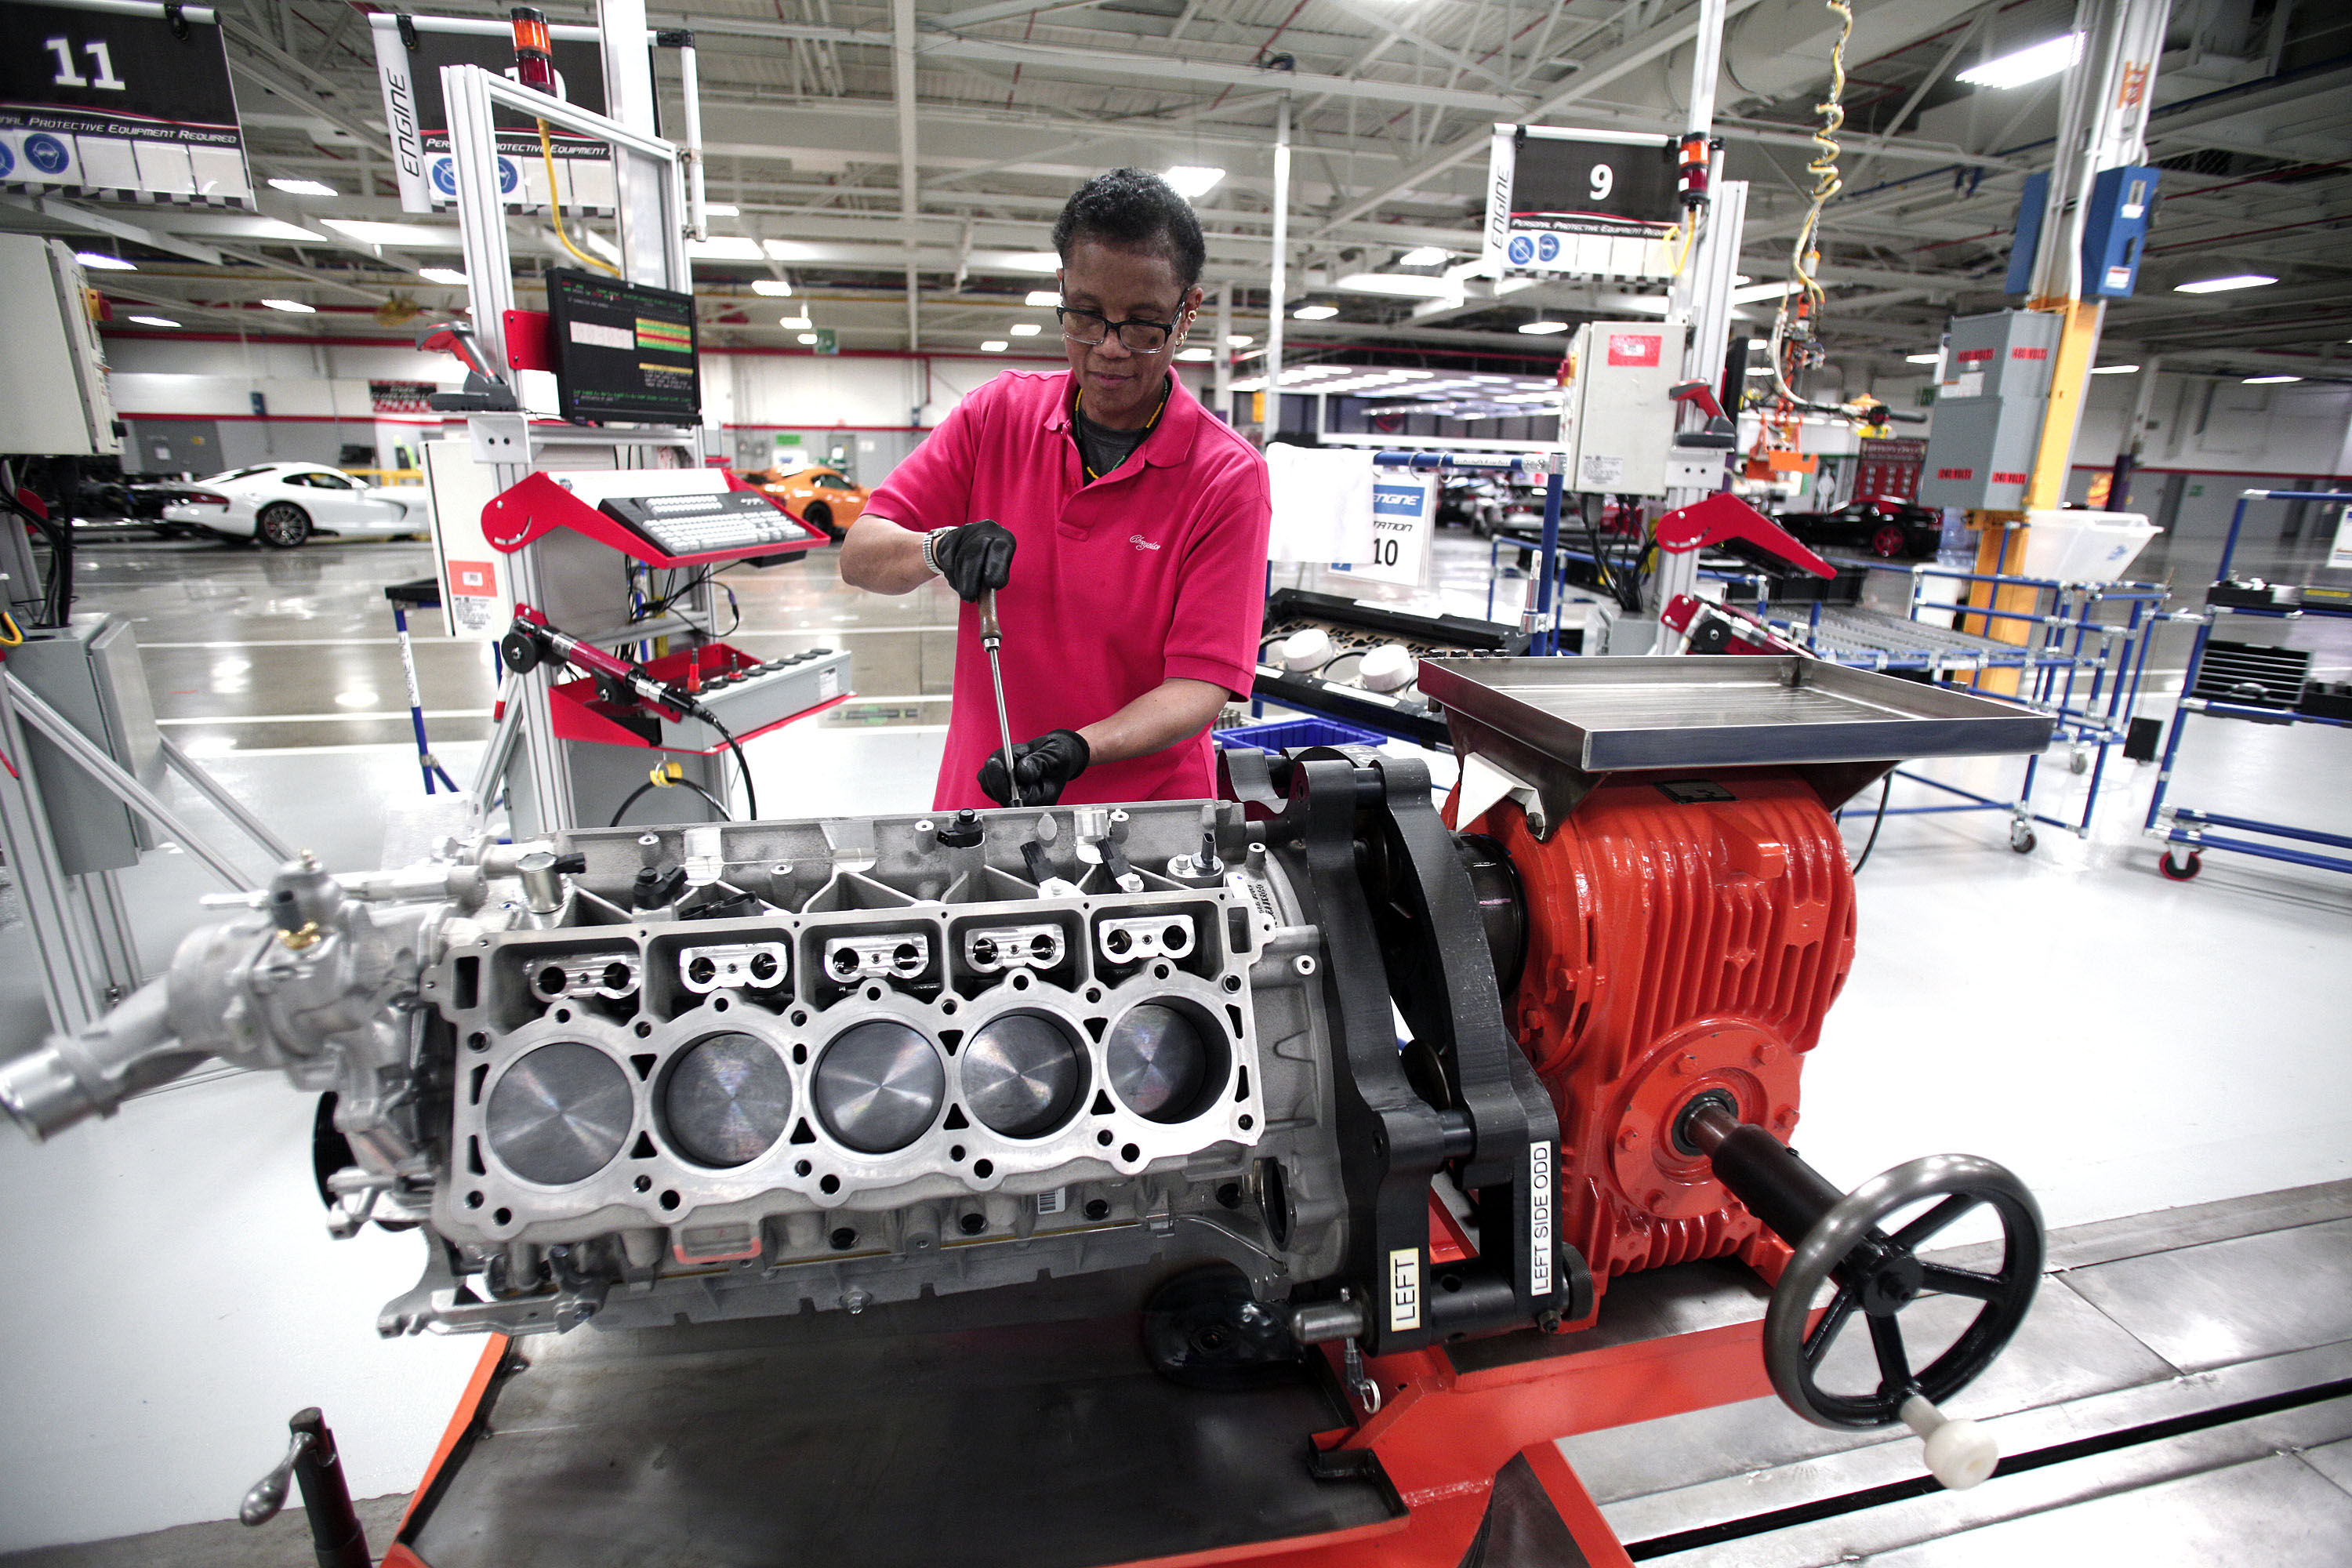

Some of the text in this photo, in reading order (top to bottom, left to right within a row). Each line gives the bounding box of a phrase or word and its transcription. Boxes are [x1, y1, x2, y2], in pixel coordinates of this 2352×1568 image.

[45, 36, 126, 91] 11
[29, 117, 104, 132] PROTECTIVE
[108, 124, 176, 139] EQUIPMENT
[179, 129, 238, 143] REQUIRED
[386, 67, 419, 178] ENGINE
[495, 143, 543, 153] OTECTIVE
[550, 144, 607, 156] EQUIPMENT
[1589, 164, 1613, 201] 9
[1491, 165, 1509, 249] ENGINE
[1975, 348, 1994, 361] VOLTS
[2013, 347, 2048, 360] 480 VOLTS
[1955, 469, 1973, 480] VOLTS
[2008, 474, 2027, 485] VOLTS
[1374, 521, 1413, 532] TATION
[1374, 538, 1398, 566] 10
[1534, 1147, 1548, 1290] LEFT SIDE ODD
[1393, 1258, 1416, 1323] LEFT
